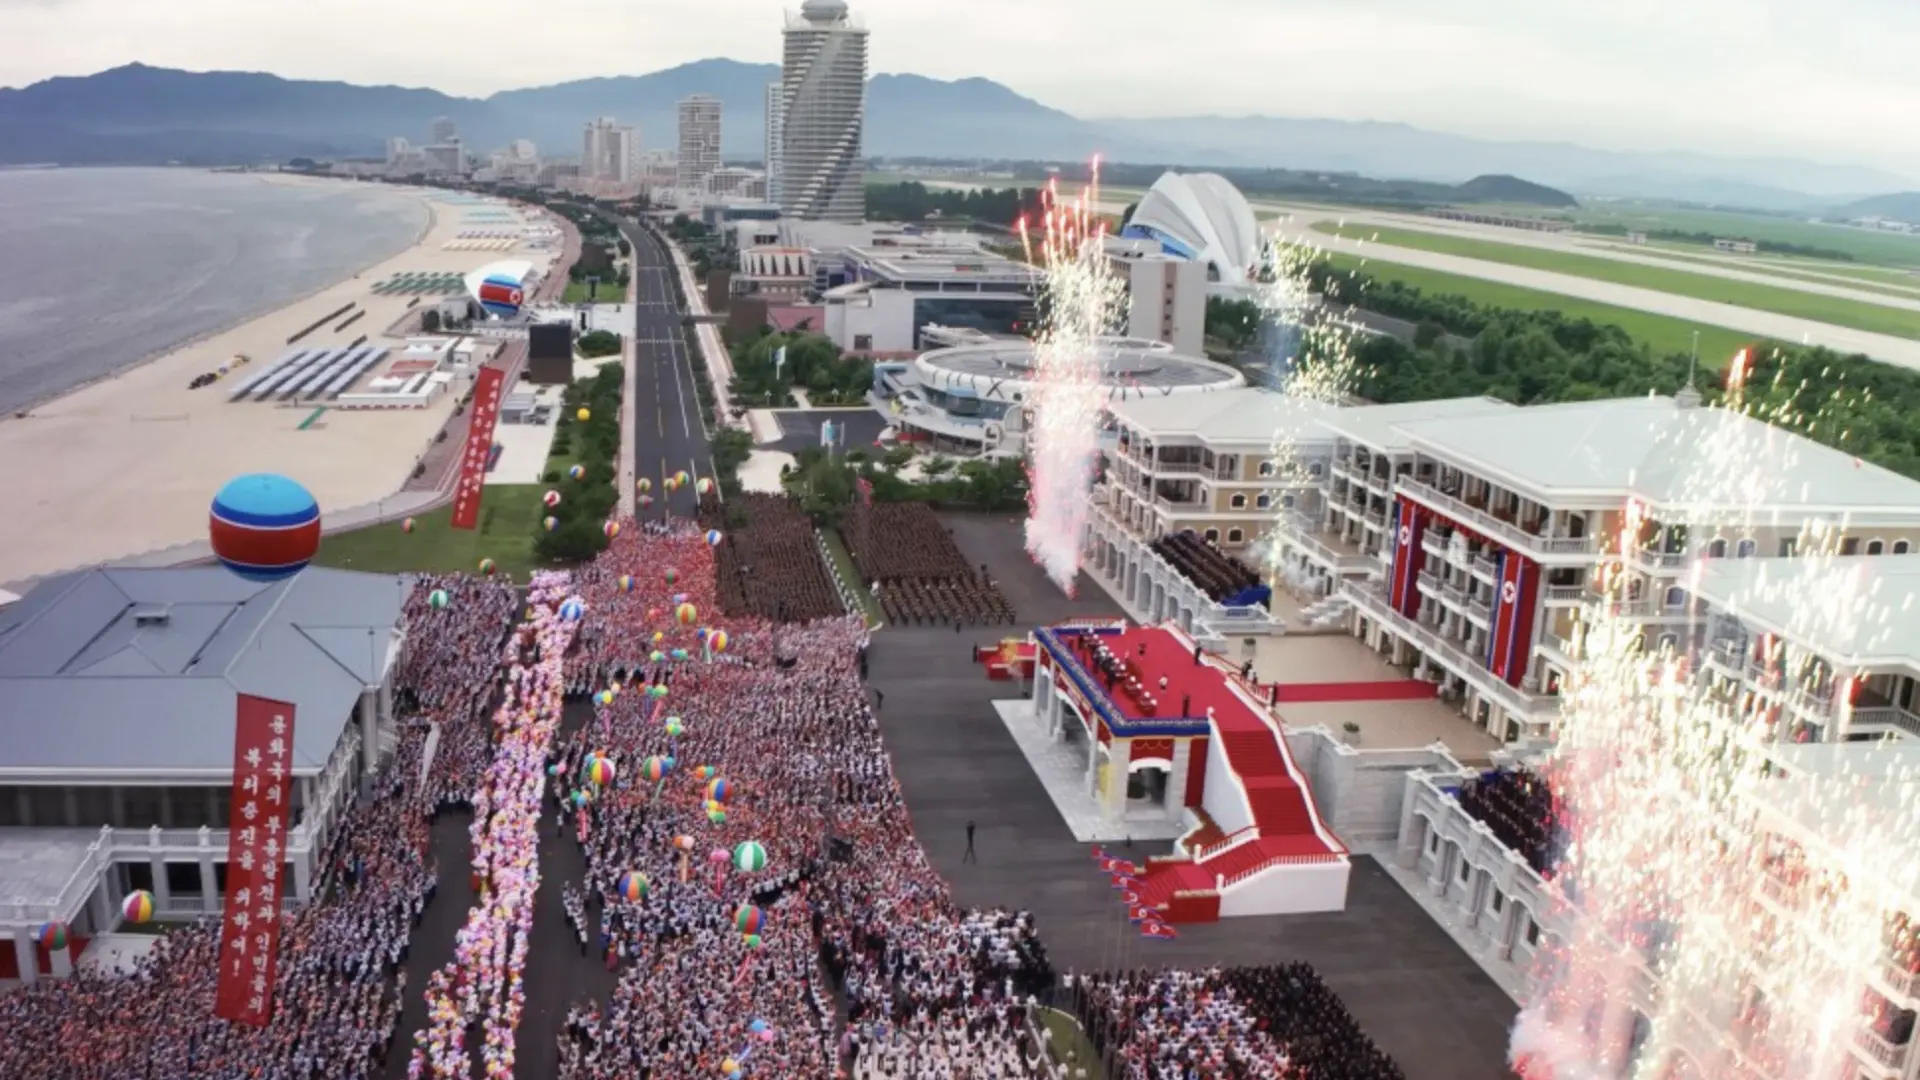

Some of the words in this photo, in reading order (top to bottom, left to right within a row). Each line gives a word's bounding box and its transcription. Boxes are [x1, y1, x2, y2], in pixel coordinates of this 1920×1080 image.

[265, 713, 288, 806] 공화국의
[236, 746, 263, 871] 복리증진을
[256, 814, 282, 925] 부흥발전과
[230, 886, 252, 978] 위하여!
[247, 931, 271, 1015] 인민들의
